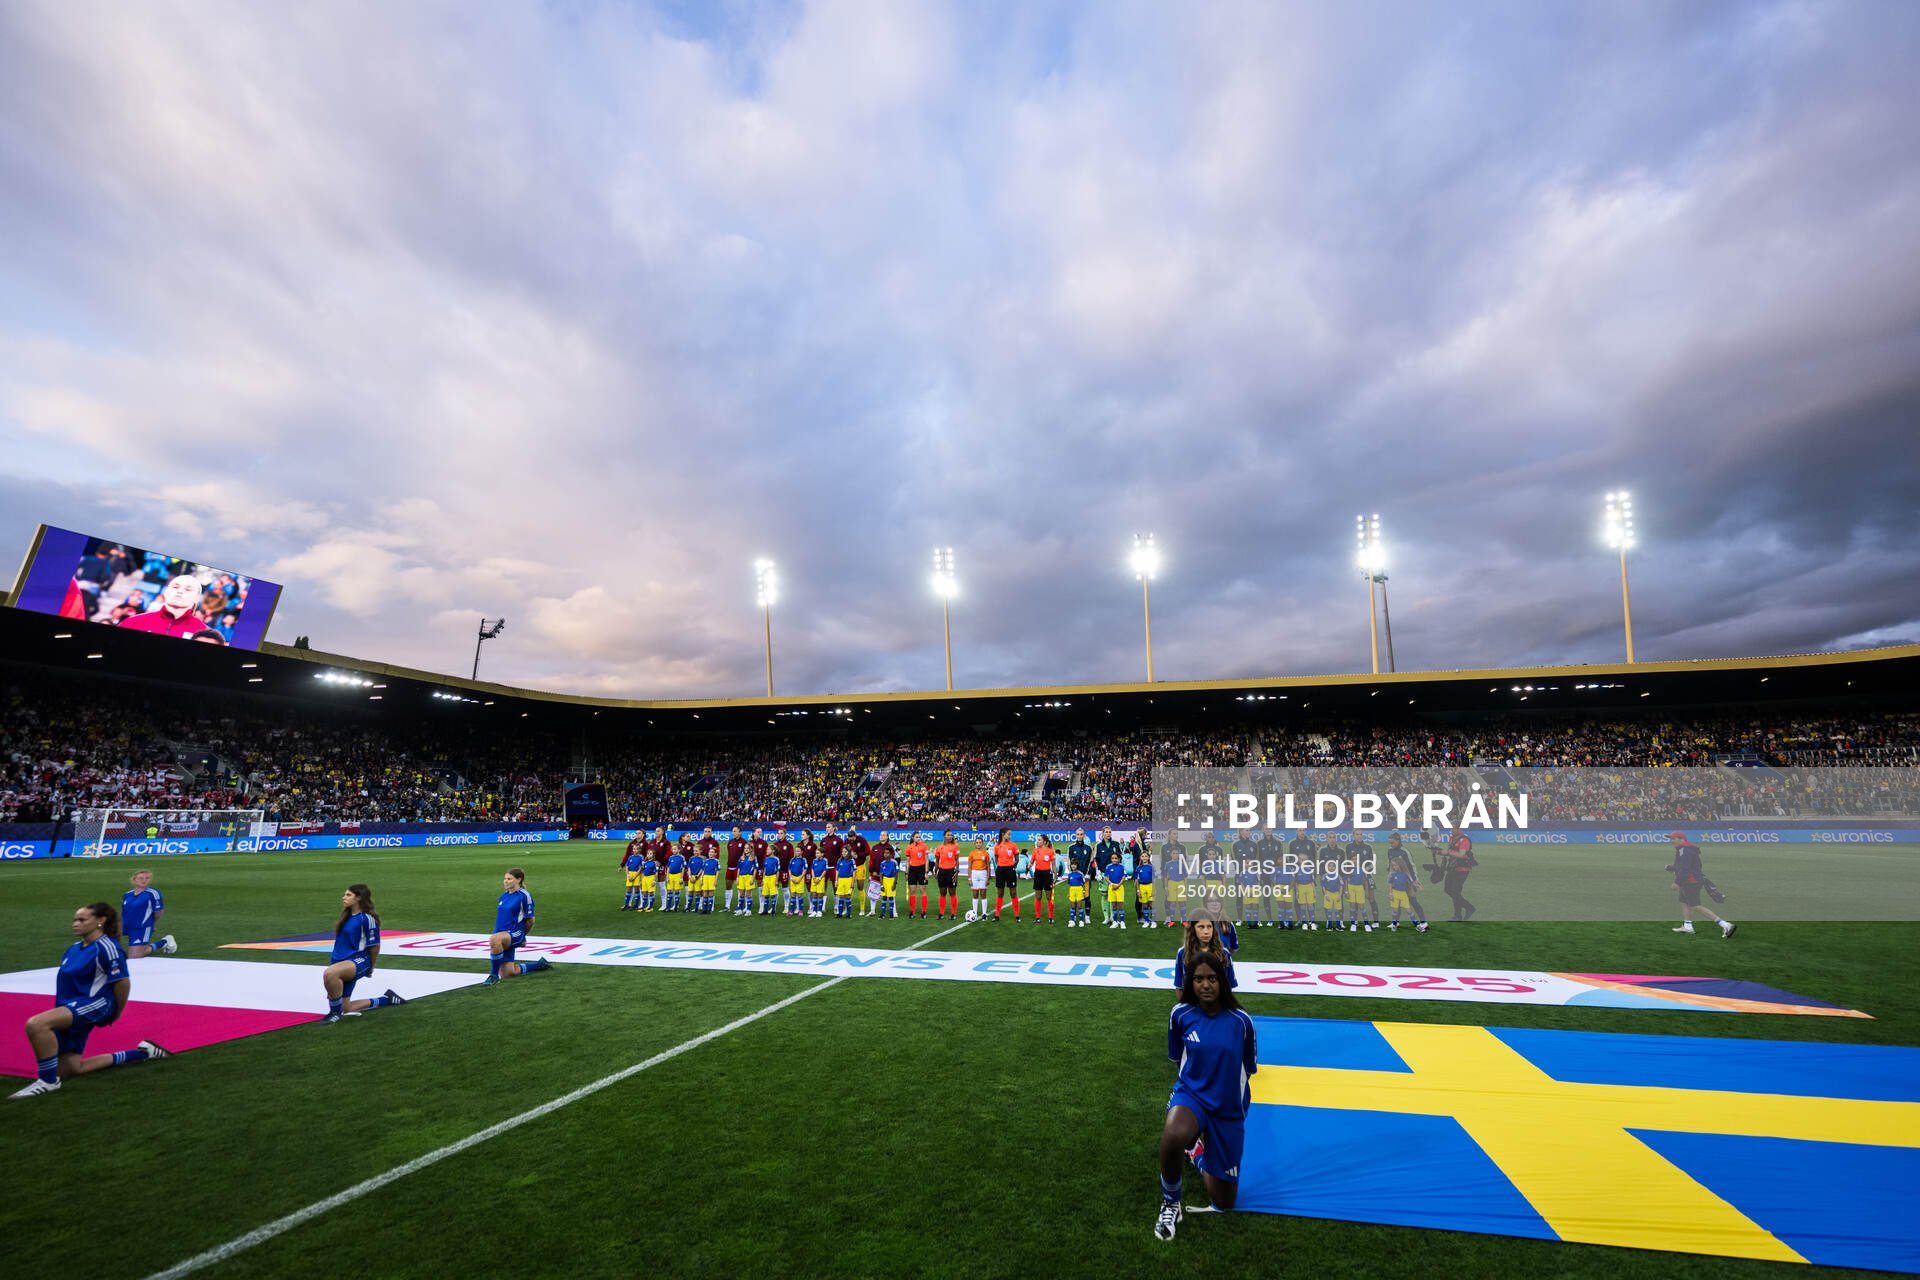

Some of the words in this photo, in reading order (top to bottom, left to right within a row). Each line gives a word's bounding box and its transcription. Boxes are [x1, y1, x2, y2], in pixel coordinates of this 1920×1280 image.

[346, 834, 403, 848] euronics
[432, 833, 479, 845] euronics
[503, 832, 542, 843] euronics
[1505, 831, 1568, 844] euronics
[1605, 831, 1671, 843] euronics
[1710, 830, 1780, 843] euronics
[1821, 829, 1894, 843] euronics
[101, 838, 189, 855] euronics
[237, 836, 308, 851] euronics
[590, 945, 949, 971] WOMEN'S
[972, 959, 1176, 980] EUR
[1256, 969, 1537, 994] 2025
